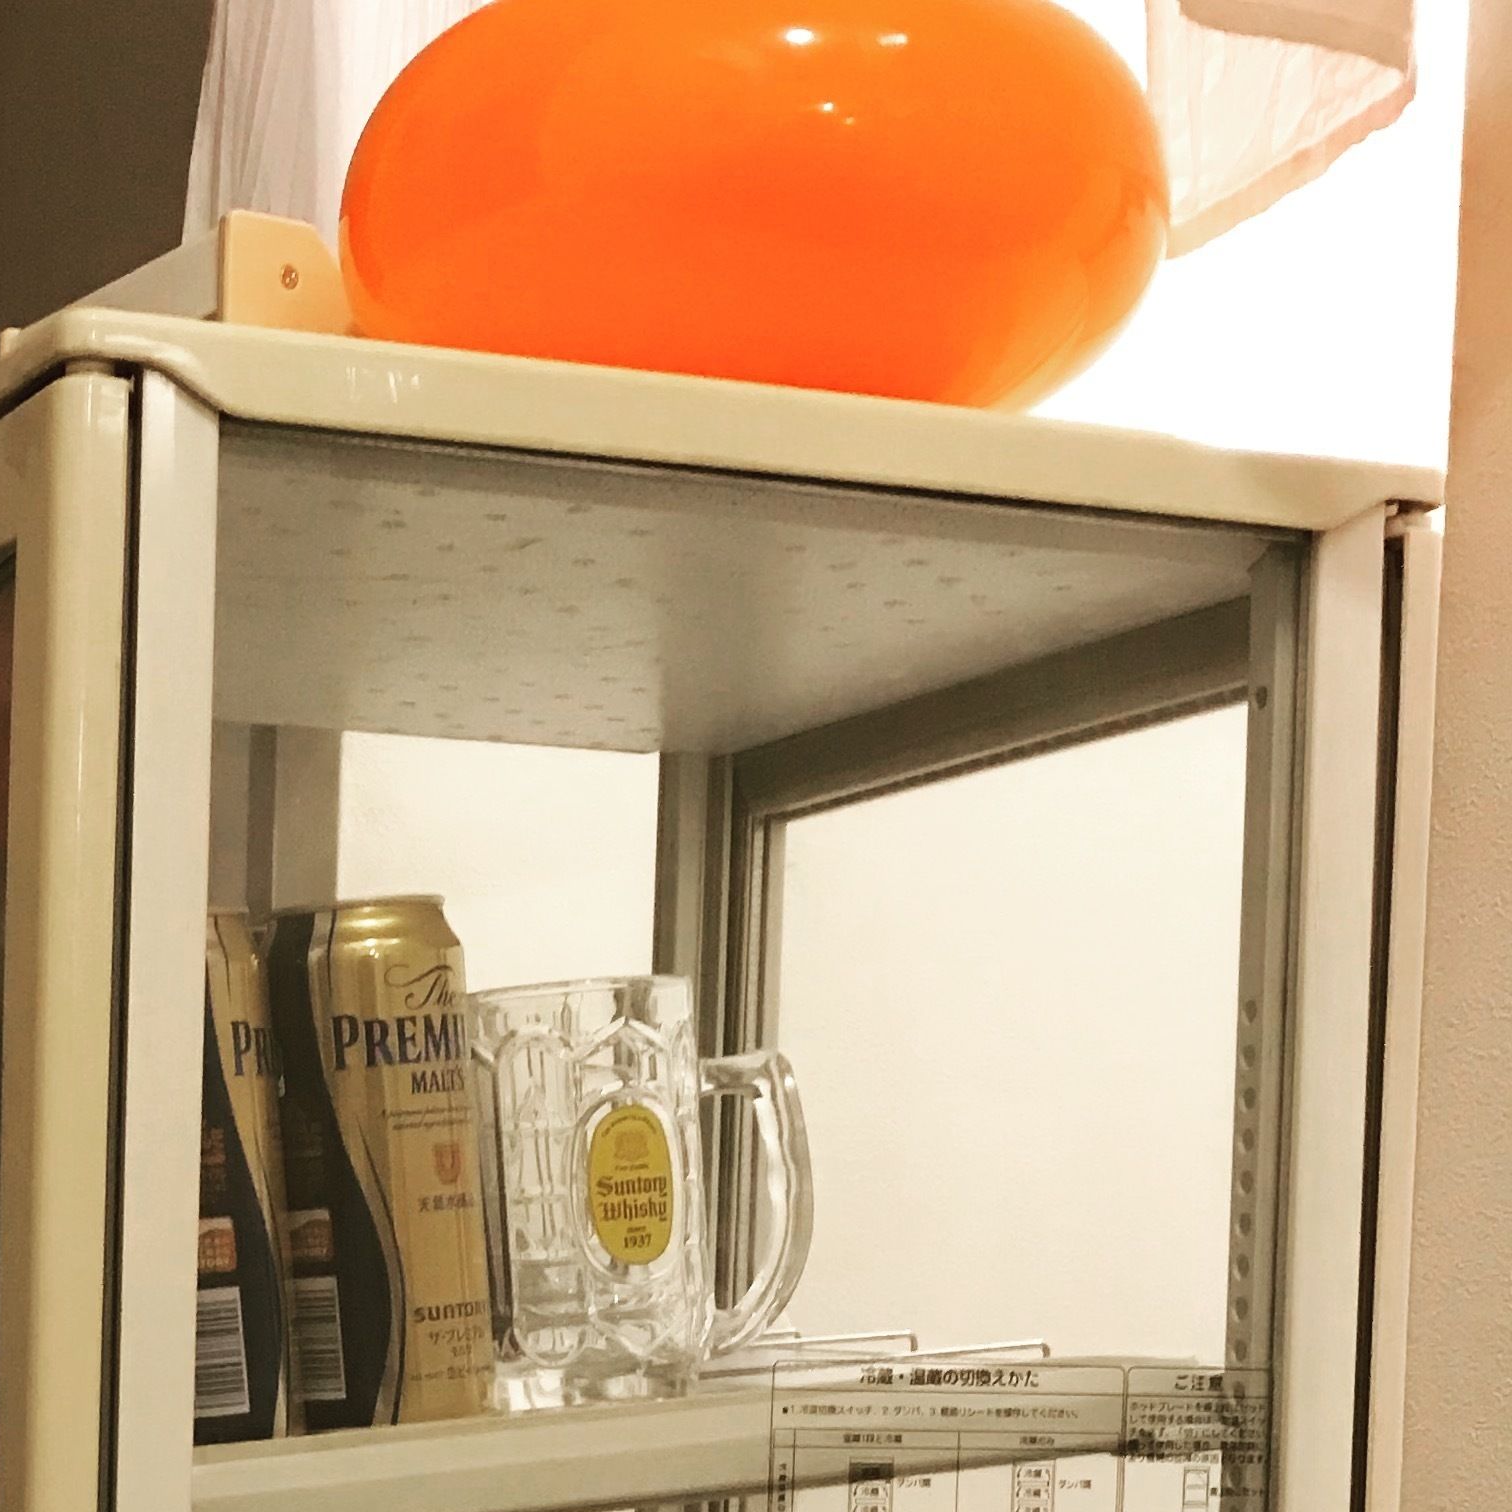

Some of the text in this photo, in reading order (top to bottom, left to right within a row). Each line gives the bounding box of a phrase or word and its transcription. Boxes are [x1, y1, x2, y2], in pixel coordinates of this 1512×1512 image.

[331, 1013, 465, 1070] PREMI
[596, 1174, 668, 1198] Suntory
[599, 1198, 668, 1222] Whisky
[623, 1233, 652, 1249] 1937
[859, 1365, 1040, 1389] 冷蔵・温蔵の切換えかた
[1173, 1373, 1225, 1392] ご注意
